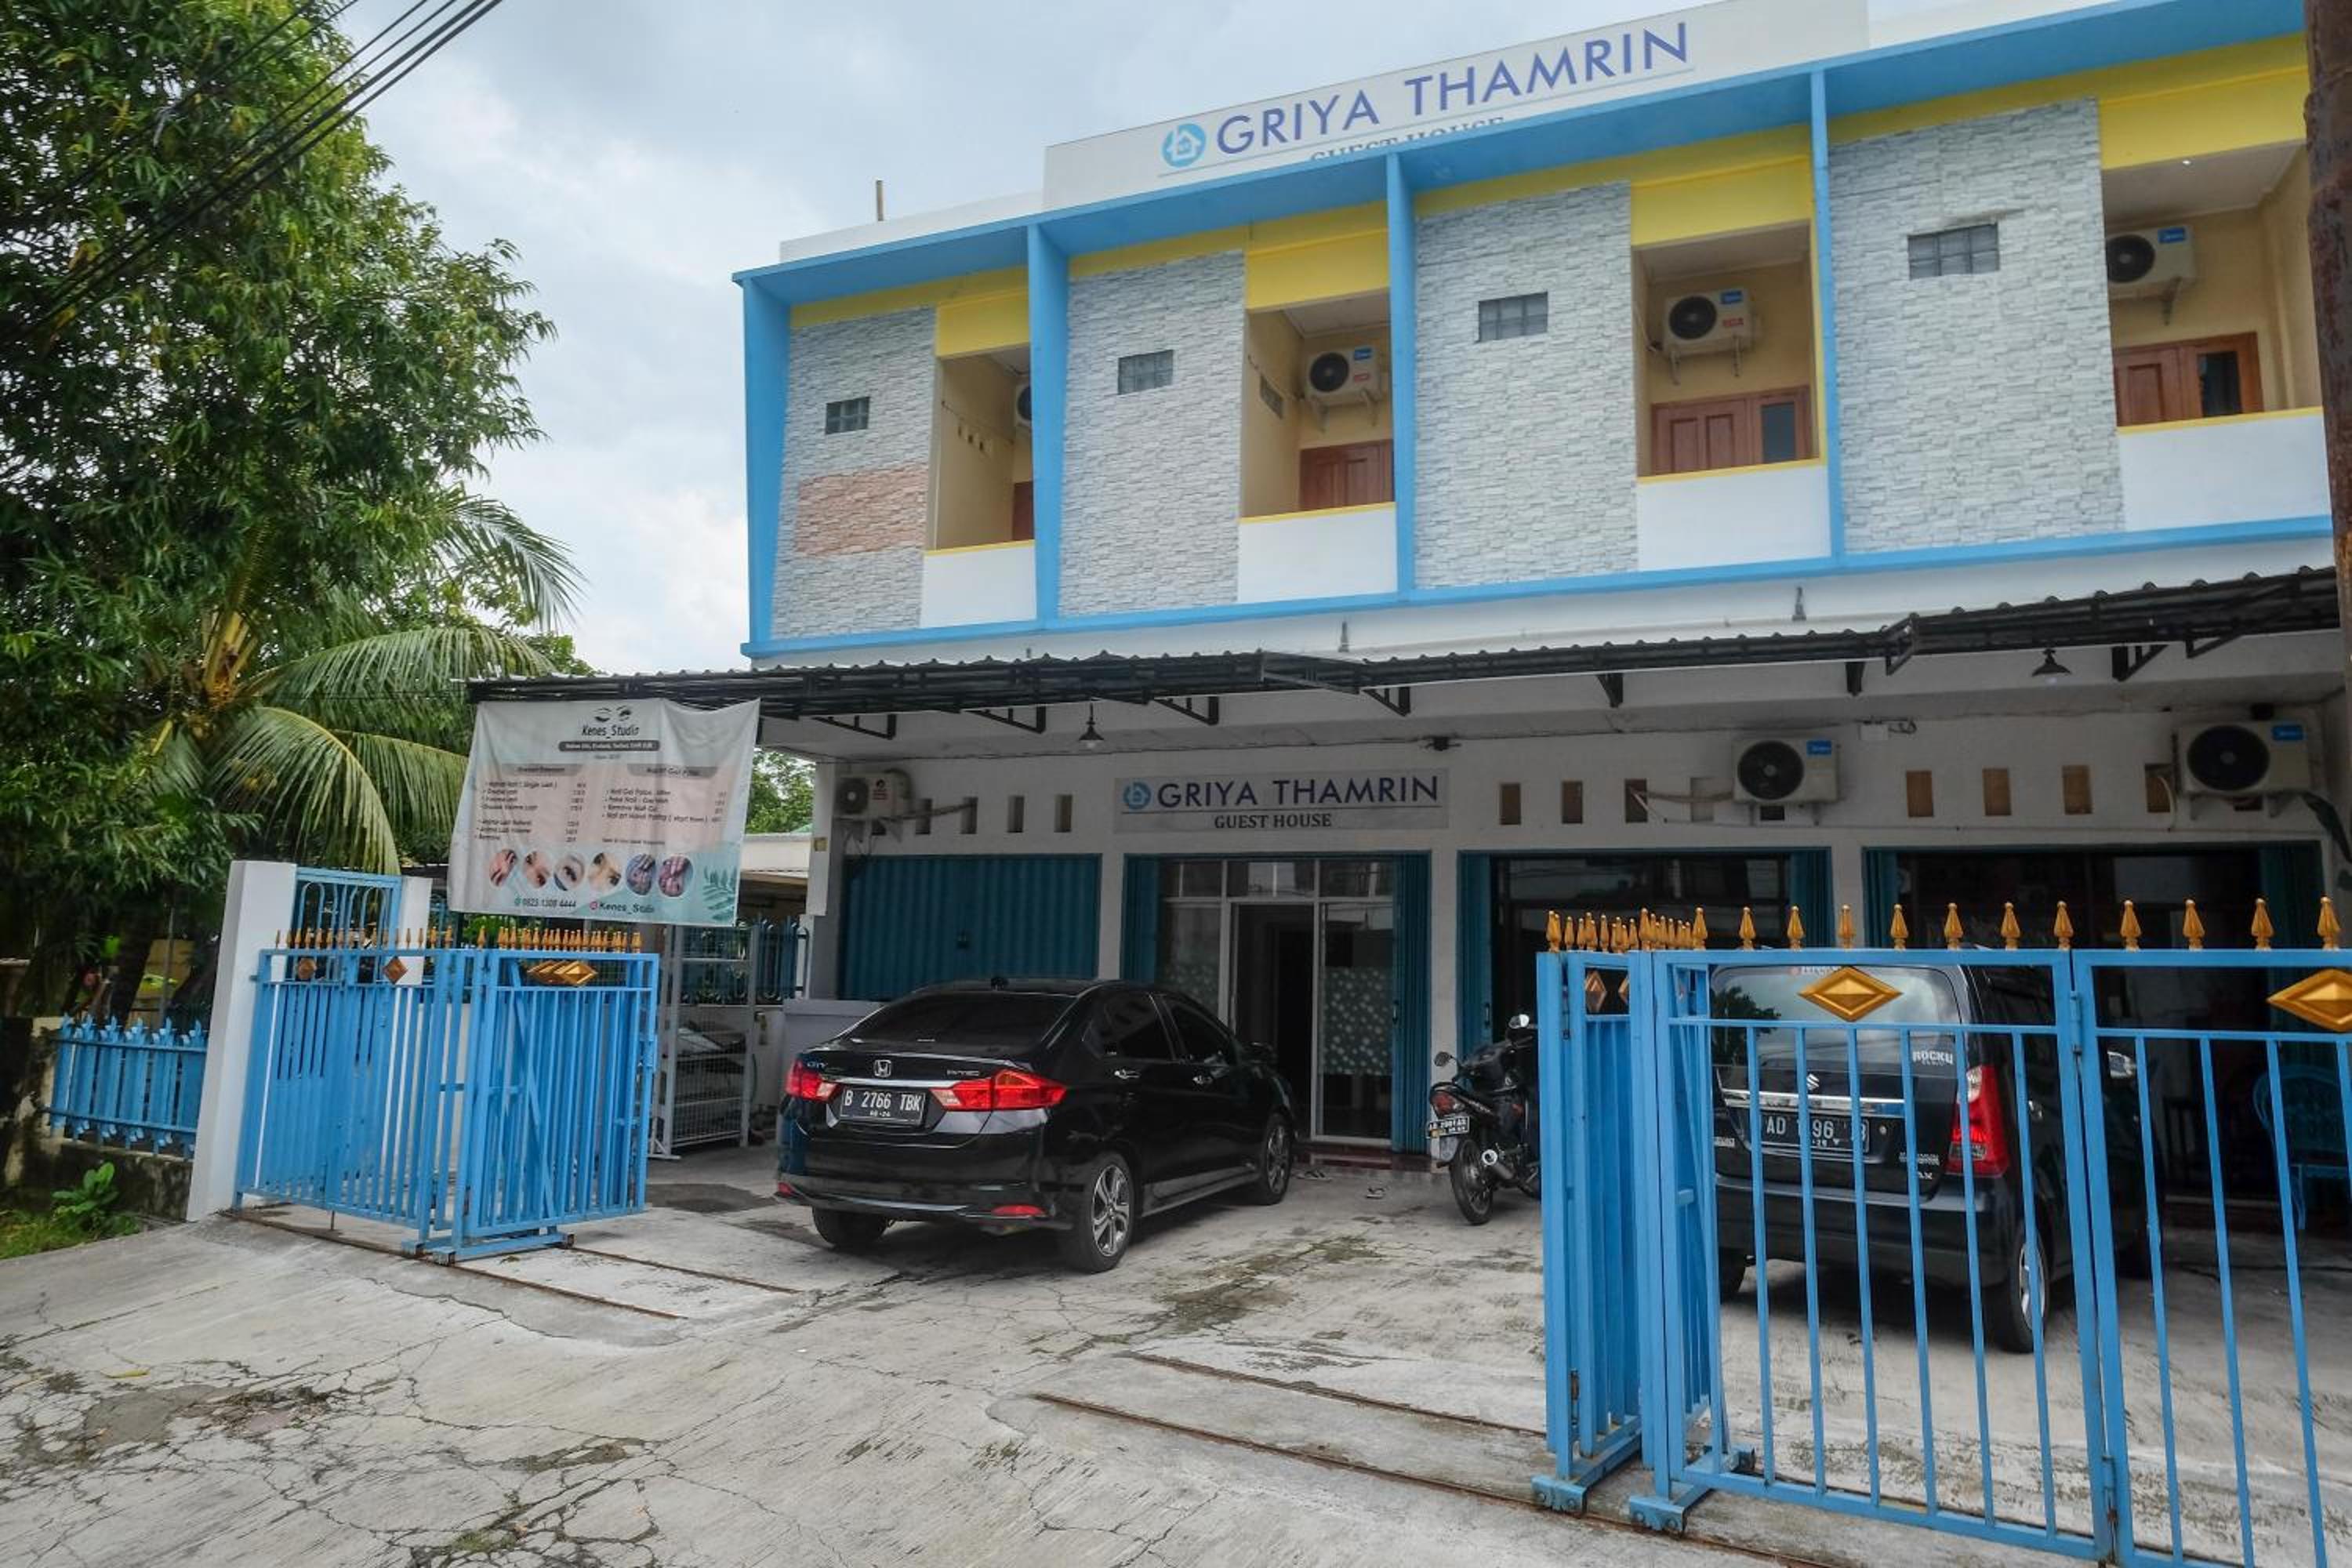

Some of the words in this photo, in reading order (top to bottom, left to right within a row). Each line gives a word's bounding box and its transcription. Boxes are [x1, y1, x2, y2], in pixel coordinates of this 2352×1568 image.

[1215, 89, 1381, 156] GRIYA
[1404, 21, 1689, 117] THAMRIN
[1156, 780, 1258, 808] GRIYA
[1272, 775, 1439, 806] THAMRIN
[1214, 813, 1269, 829] GUEST
[1272, 812, 1332, 828] HOUSE
[844, 1089, 854, 1106] B
[861, 1091, 892, 1109] 2766
[899, 1093, 922, 1112] TBK
[1766, 1115, 1787, 1135] AD
